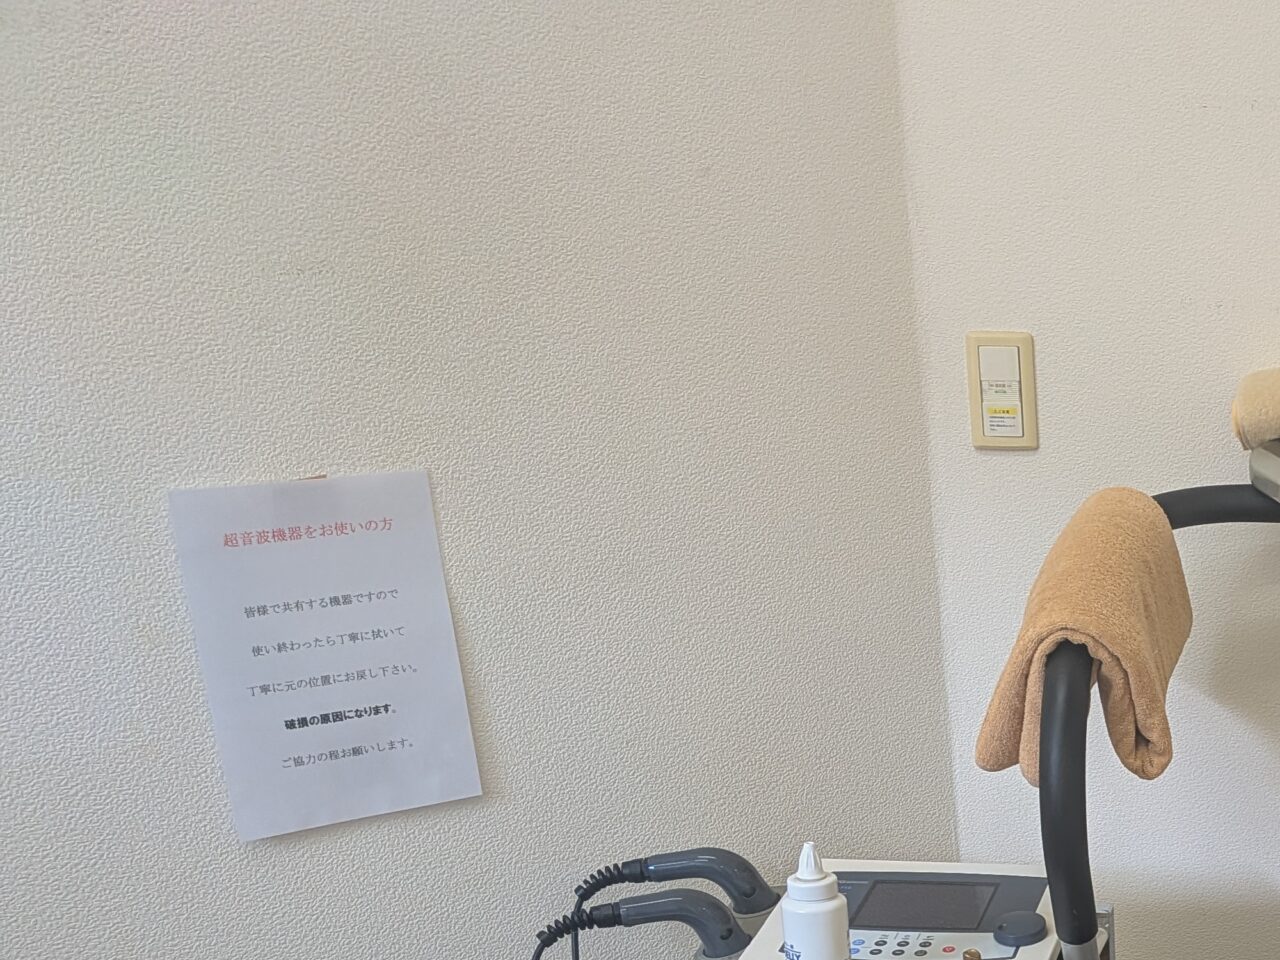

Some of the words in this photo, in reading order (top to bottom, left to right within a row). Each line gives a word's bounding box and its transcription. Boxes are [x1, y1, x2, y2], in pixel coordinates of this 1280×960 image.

[223, 516, 394, 549] 超音波機器をお使いの方
[243, 588, 399, 619] 皆様で共有する機器ですので
[251, 625, 406, 658] 使い終わったら丁寧に拭いて
[246, 662, 418, 698] 丁寧に元の位置にお戻し下さい。
[283, 703, 397, 731] 破損の原因になります。
[281, 737, 414, 769] ご協力の程お願いします。
